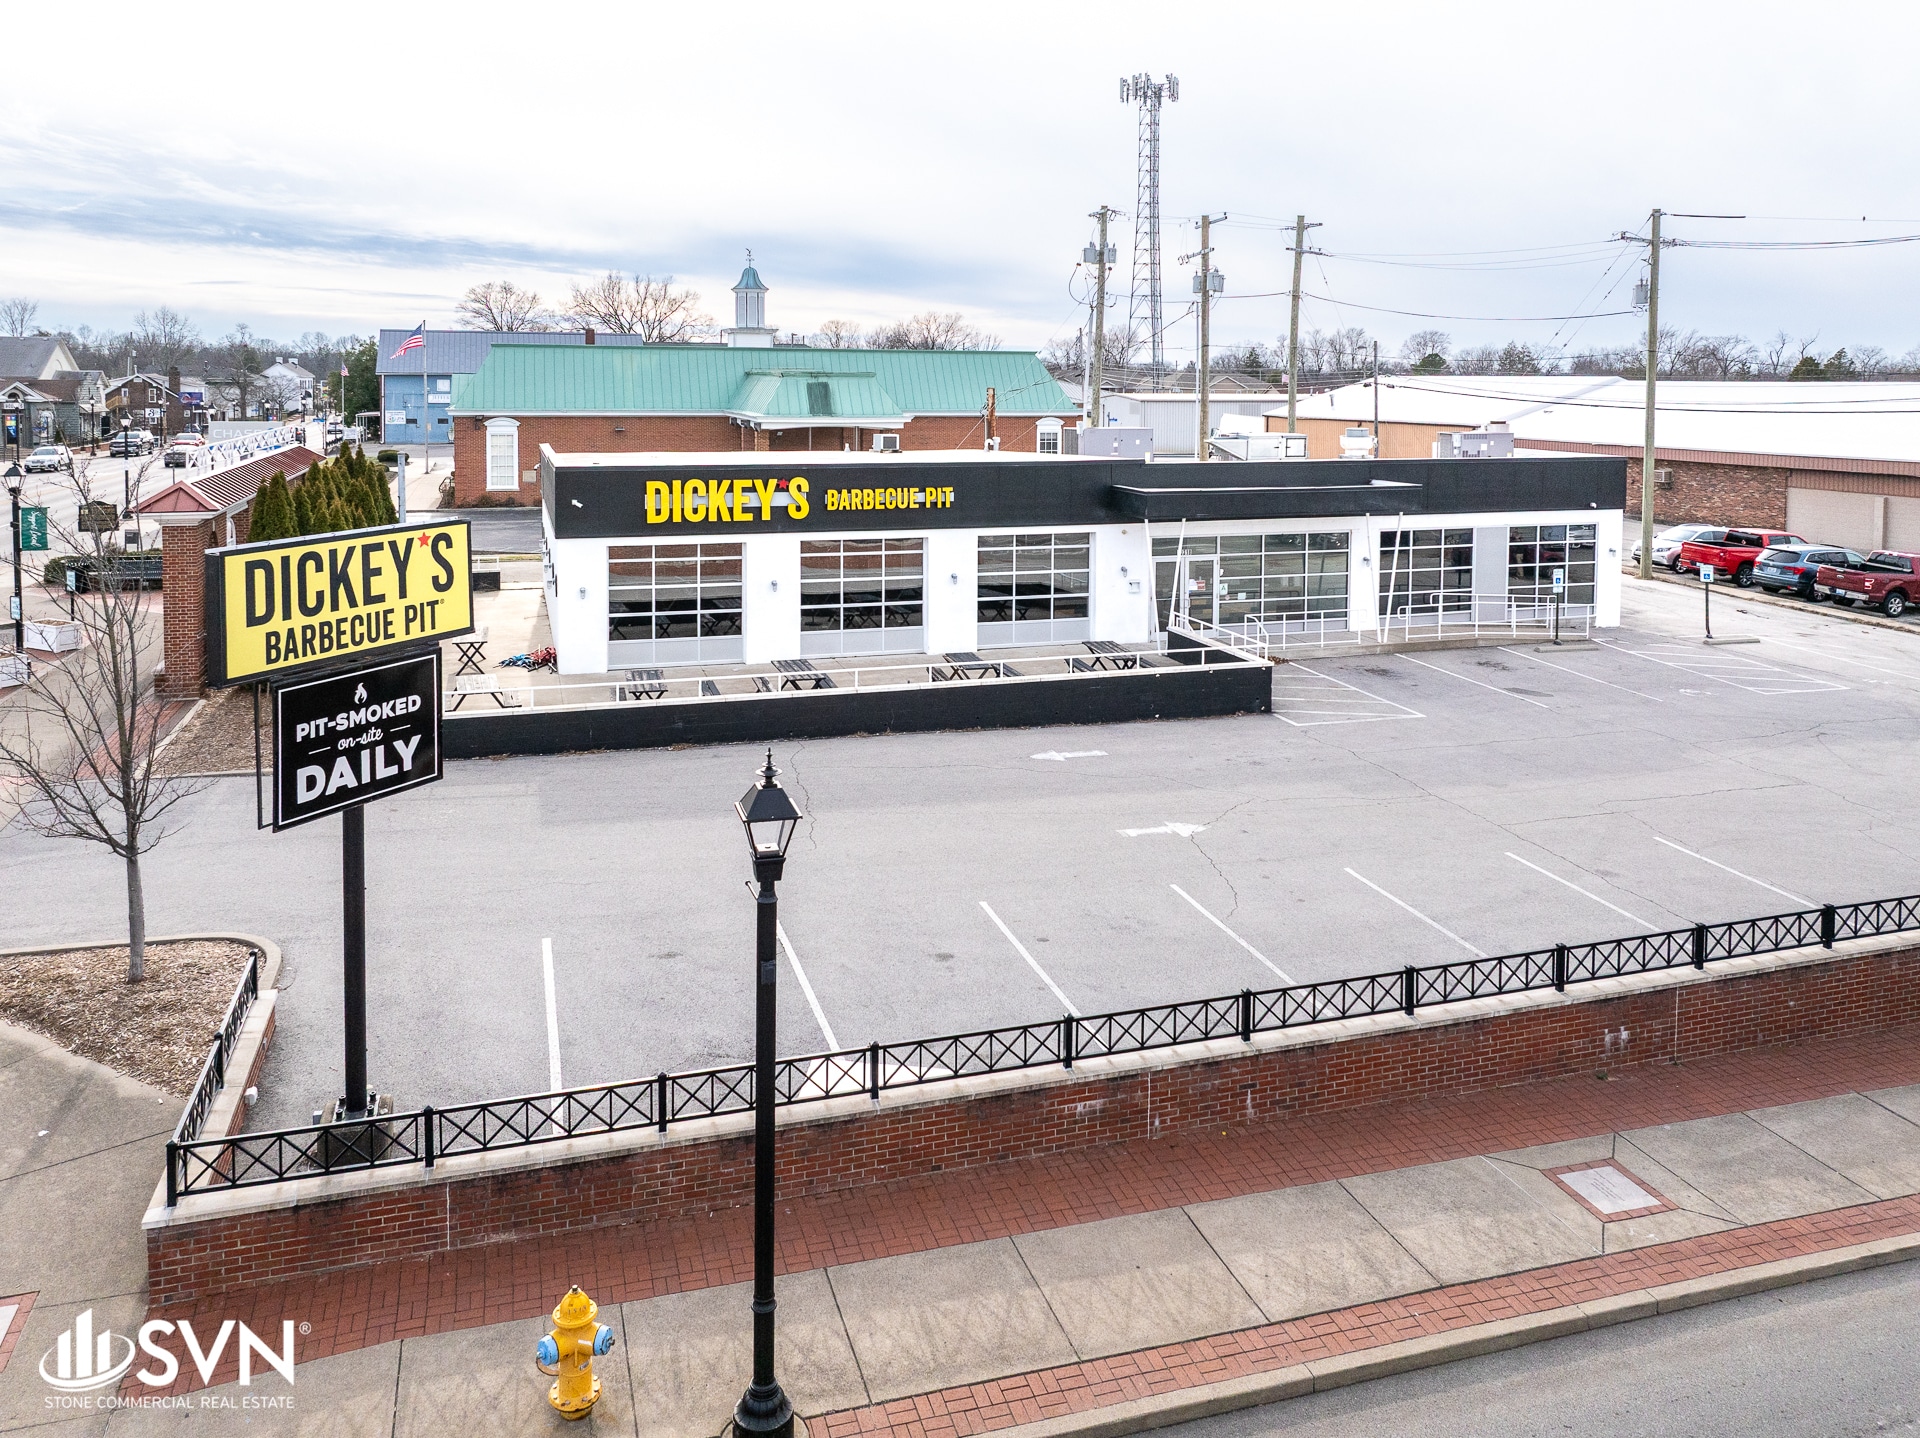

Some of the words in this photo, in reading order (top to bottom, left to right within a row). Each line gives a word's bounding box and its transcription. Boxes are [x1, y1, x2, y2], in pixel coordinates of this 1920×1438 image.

[646, 477, 810, 524] DICKEY'S
[827, 488, 919, 511] BARBECUE
[926, 487, 953, 509] PIT
[245, 532, 455, 628] DICKEY'S
[265, 608, 396, 666] BARBECUE
[296, 694, 422, 743] PIT-SMOKED
[337, 726, 384, 751] on-site
[296, 735, 422, 805] DAILY
